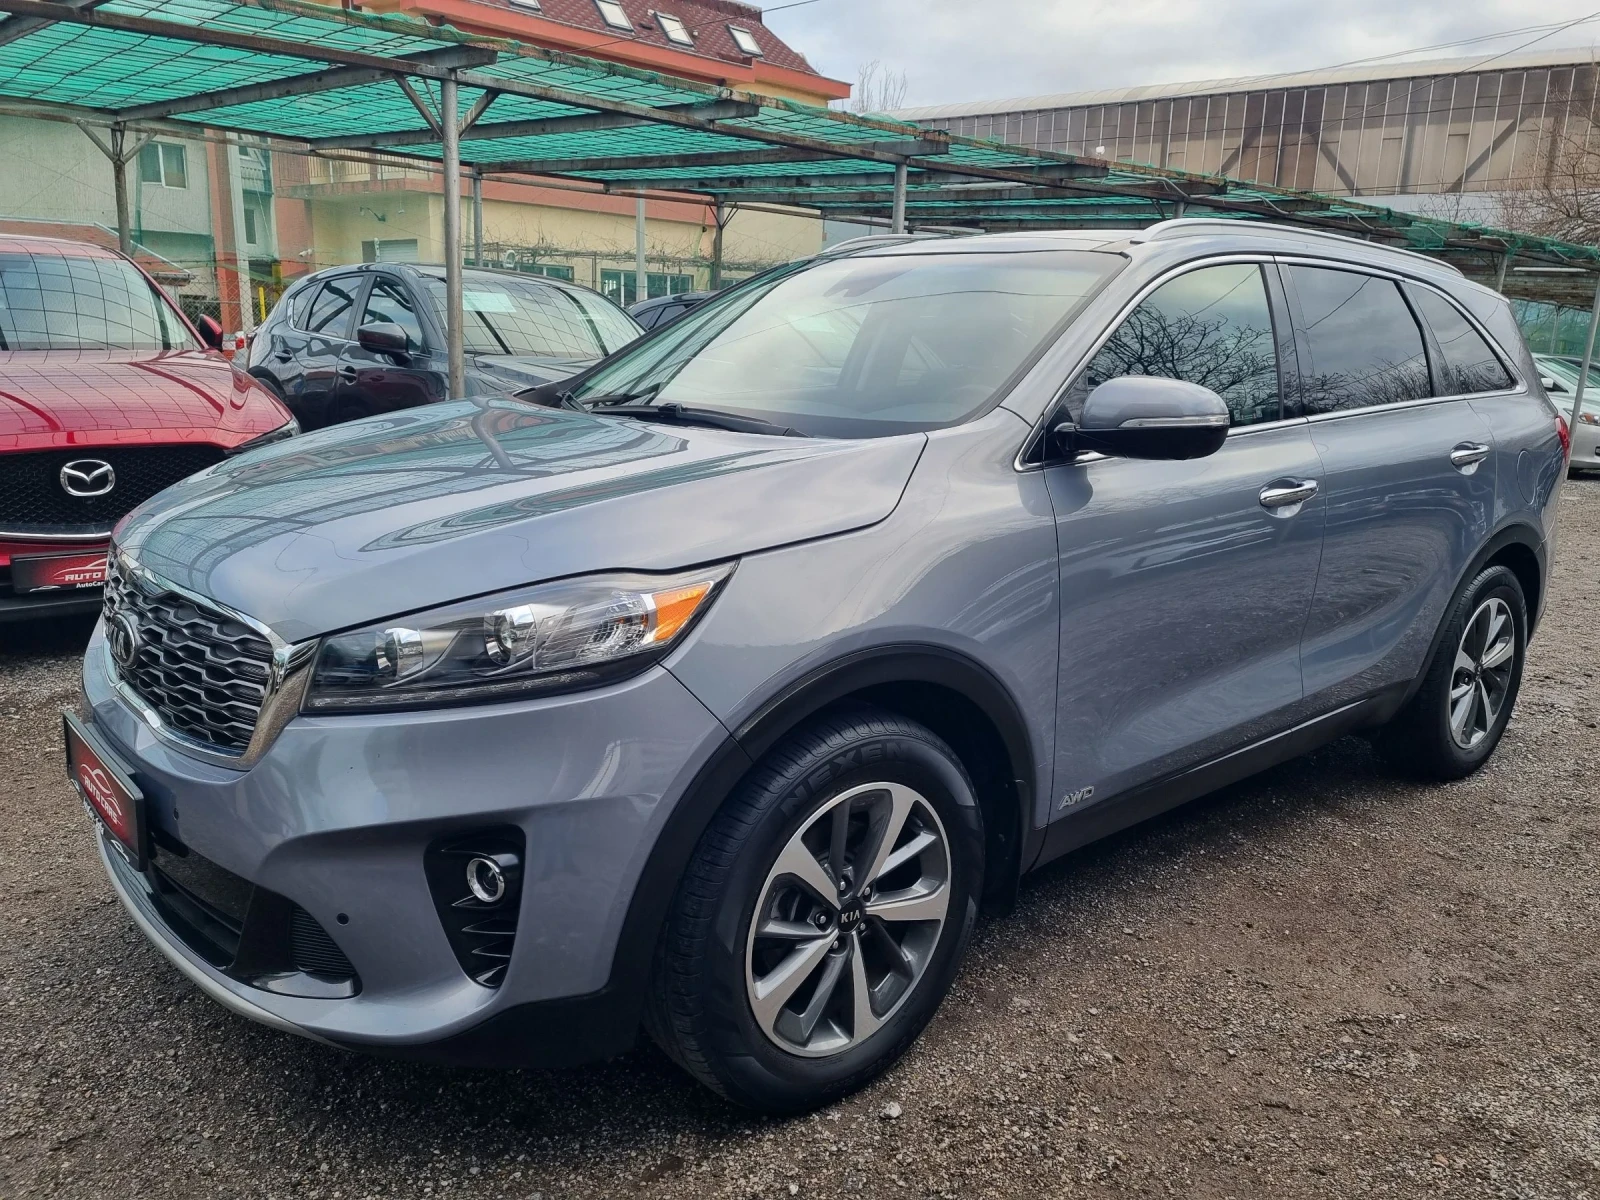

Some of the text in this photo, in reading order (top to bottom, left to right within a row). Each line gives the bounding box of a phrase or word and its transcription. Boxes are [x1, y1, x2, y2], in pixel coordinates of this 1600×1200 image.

[65, 572, 102, 581] AUTO
[780, 742, 903, 816] NEXEN
[84, 776, 100, 803] AUTO
[100, 798, 118, 825] CARS
[1057, 786, 1094, 810] AWD
[841, 910, 860, 923] KIA
